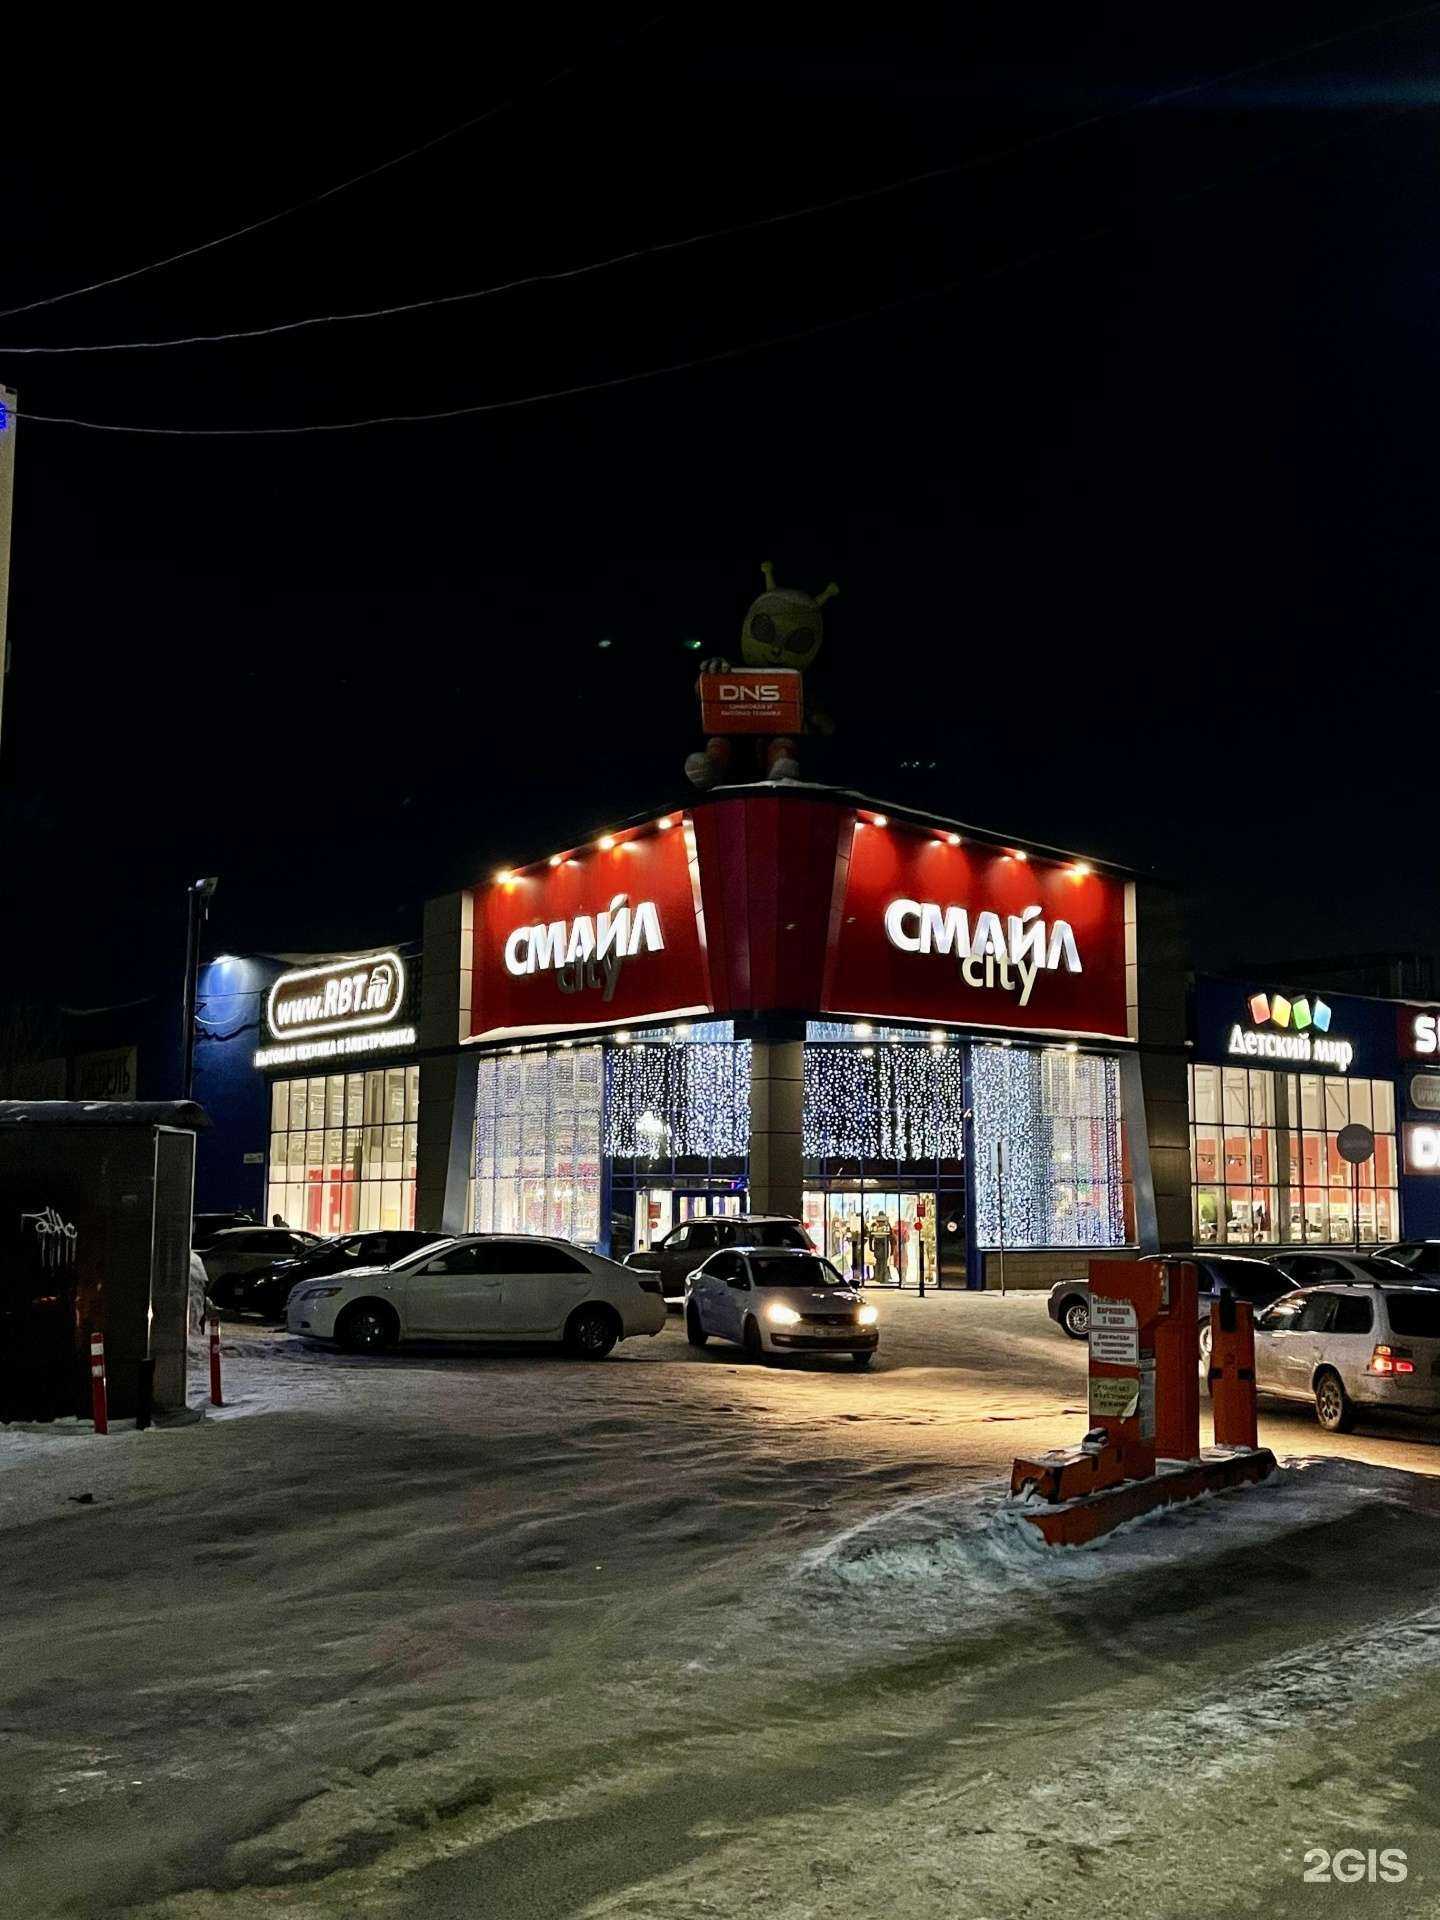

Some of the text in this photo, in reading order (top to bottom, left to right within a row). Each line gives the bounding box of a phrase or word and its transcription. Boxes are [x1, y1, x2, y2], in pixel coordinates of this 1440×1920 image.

[719, 685, 781, 701] DNS
[505, 893, 665, 976] СМАЙЛ
[885, 899, 1083, 974] СМАЙЛ
[277, 973, 389, 1025] www.RBT.ru
[557, 944, 623, 1003] city
[962, 940, 1039, 1007] city
[1228, 1023, 1353, 1072] Детский мир
